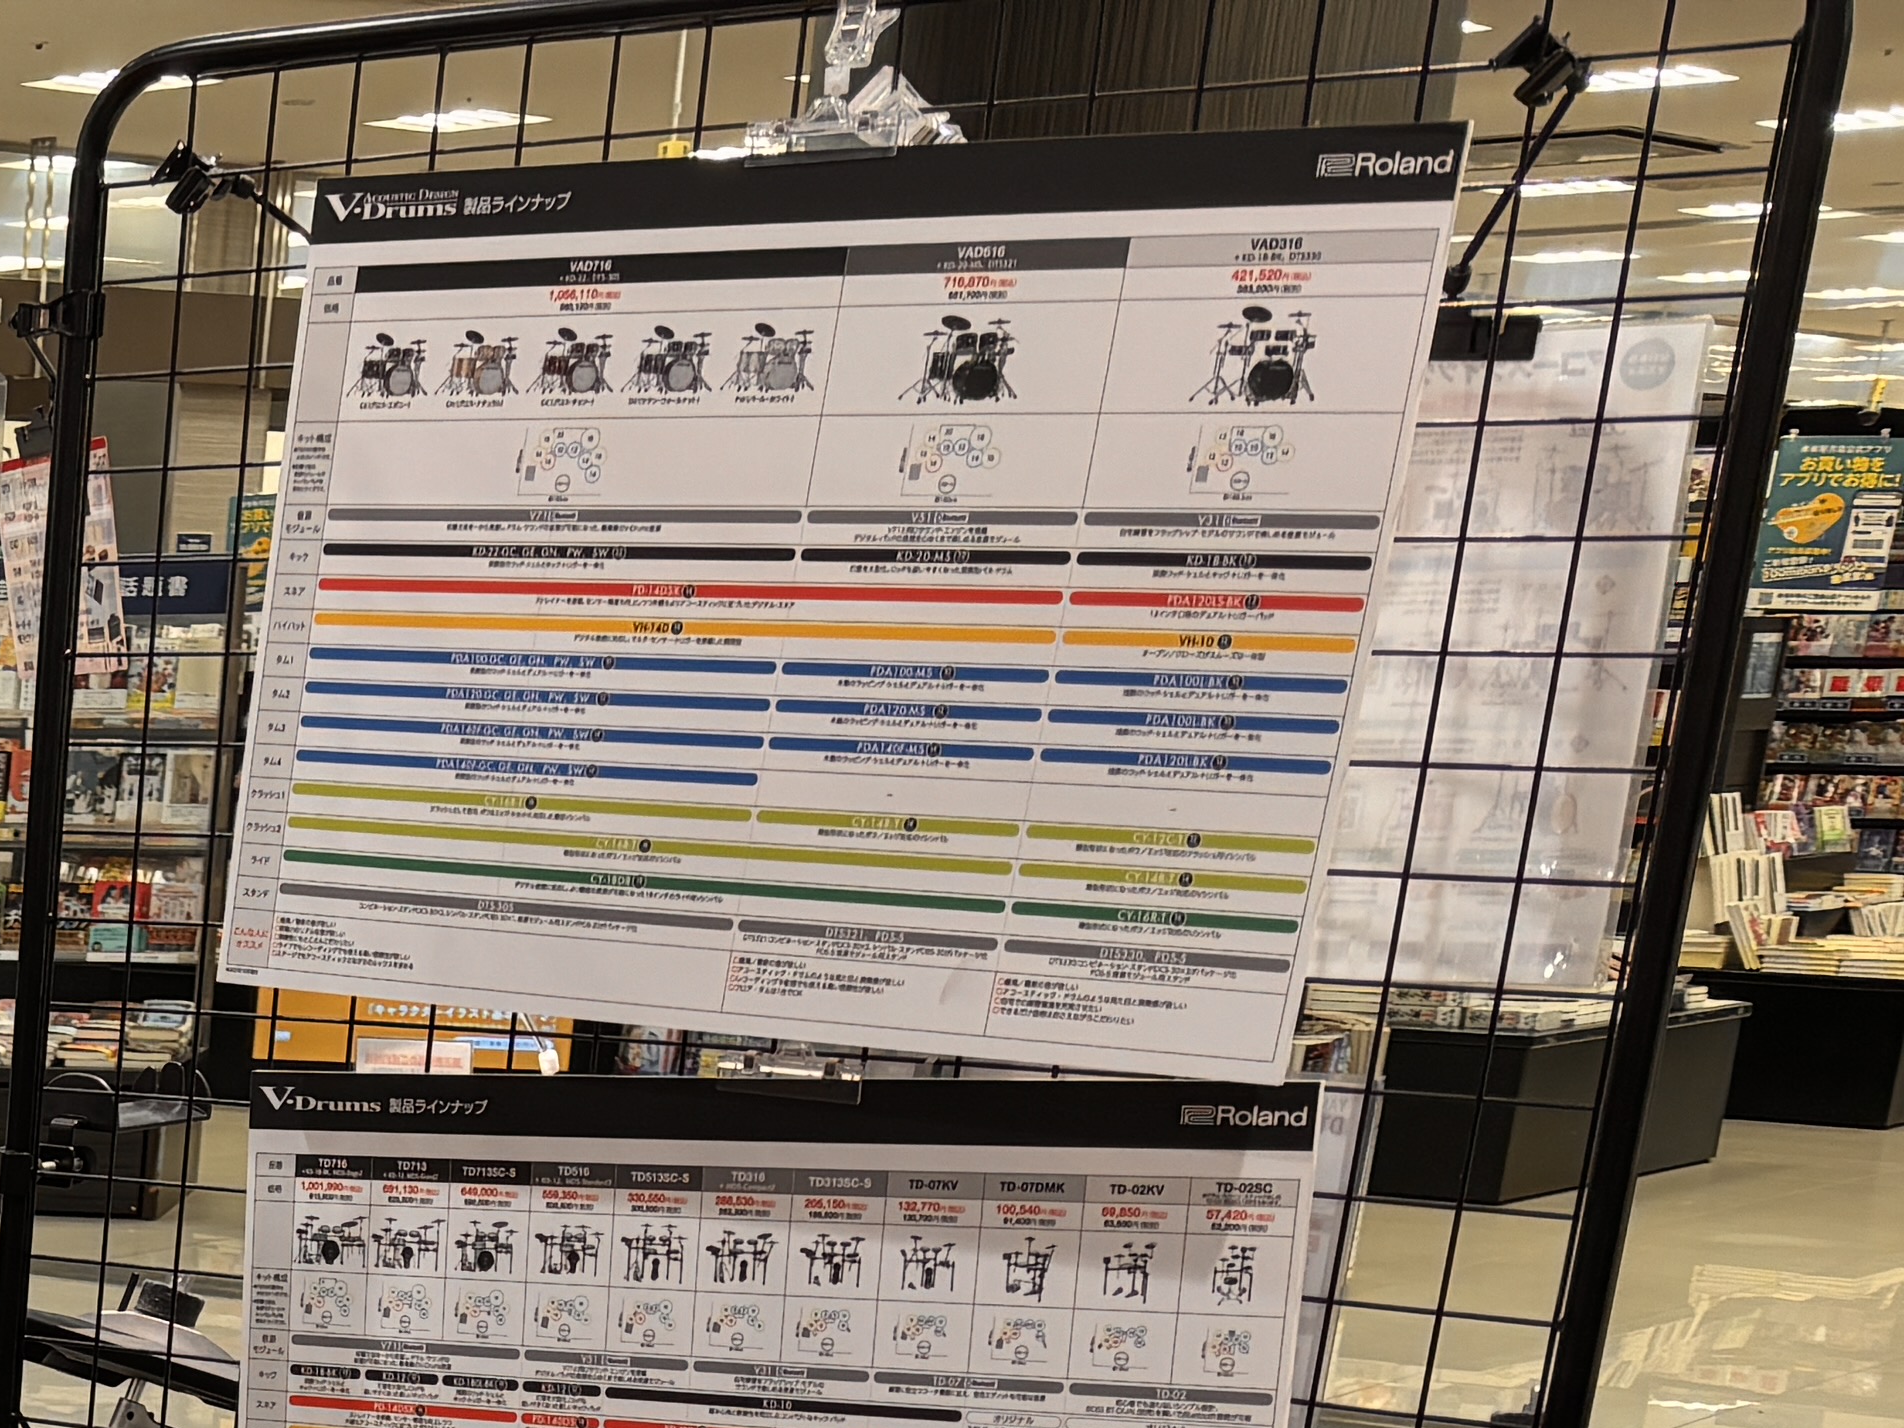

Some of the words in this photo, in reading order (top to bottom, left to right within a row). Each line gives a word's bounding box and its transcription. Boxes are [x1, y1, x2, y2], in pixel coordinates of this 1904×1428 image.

[1354, 149, 1454, 178] Roland
[462, 189, 573, 216] 製品ラインナップ
[1799, 455, 1887, 473] お買い物を
[388, 1097, 489, 1116] 製品ラインナップ
[1214, 1104, 1309, 1127] Roland
[907, 1178, 961, 1192] TD-07KV
[998, 1180, 1068, 1196] TD-07DMK
[1108, 1182, 1167, 1198] TD-02KV
[1215, 1180, 1275, 1196] TD-02SC
